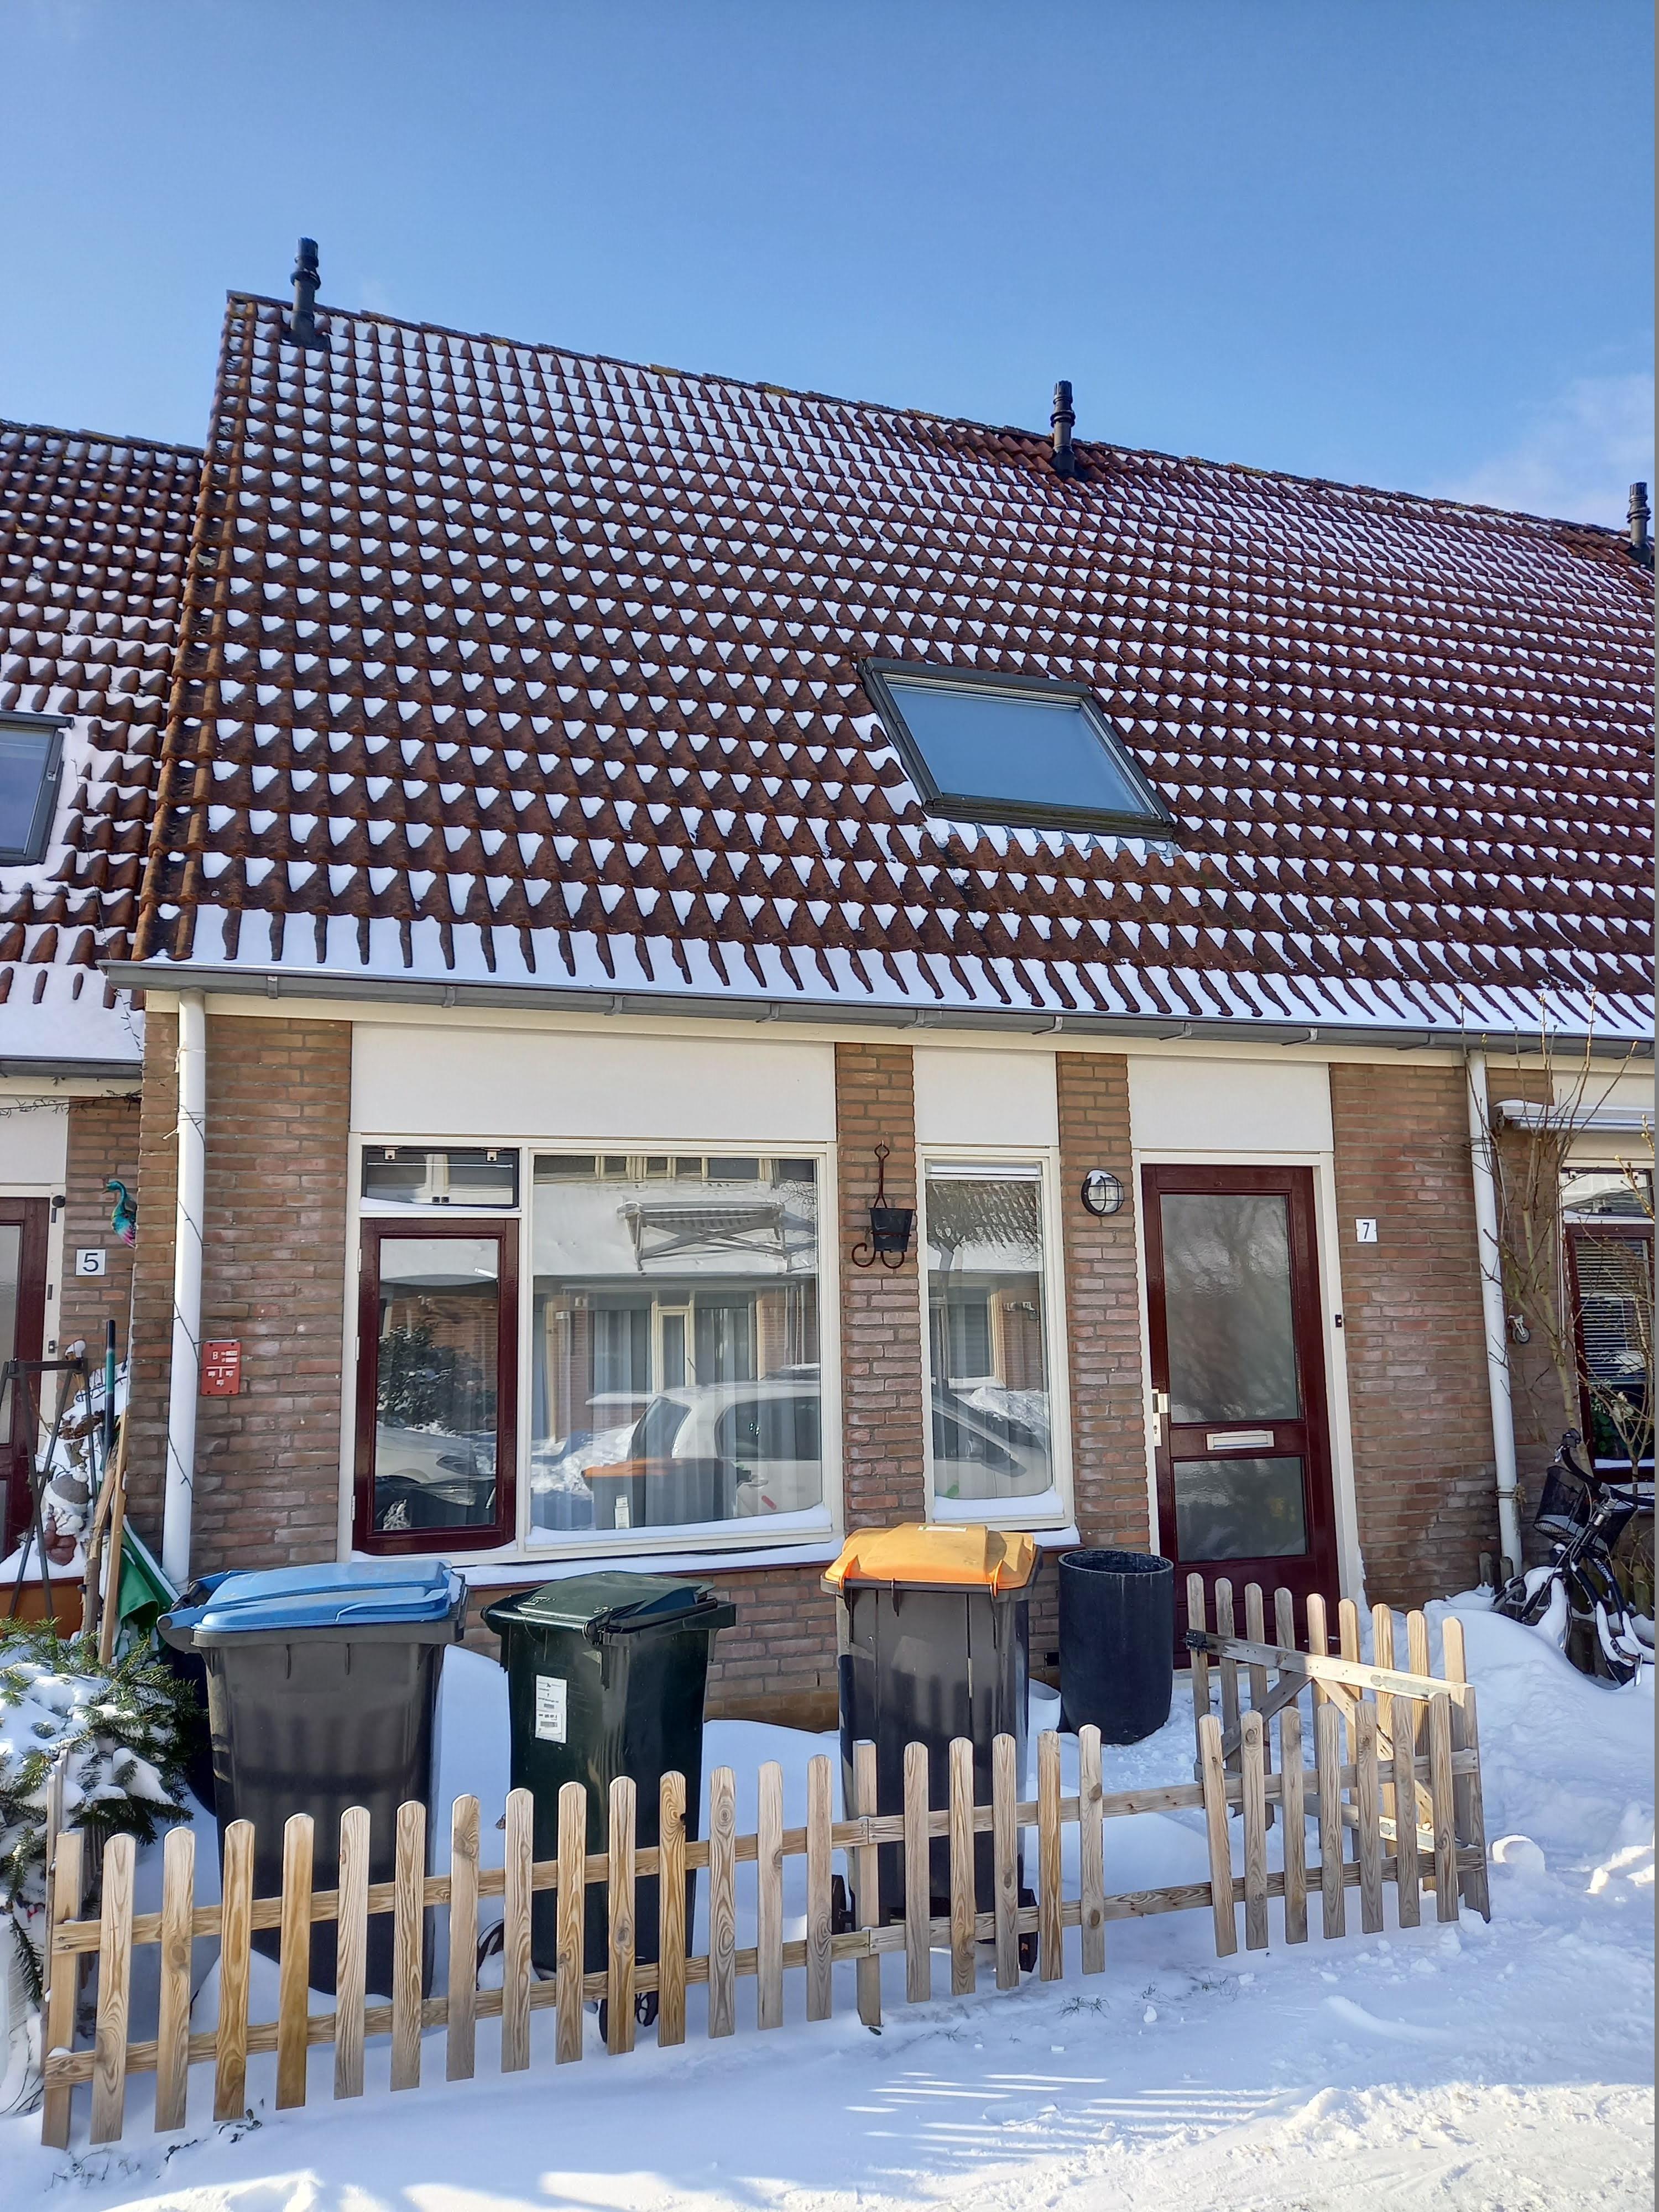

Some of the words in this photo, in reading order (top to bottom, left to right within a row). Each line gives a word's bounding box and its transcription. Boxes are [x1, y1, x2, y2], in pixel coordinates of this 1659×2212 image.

[1363, 1222, 1370, 1239] 7
[83, 1253, 99, 1272] 5
[212, 1351, 218, 1360] B
